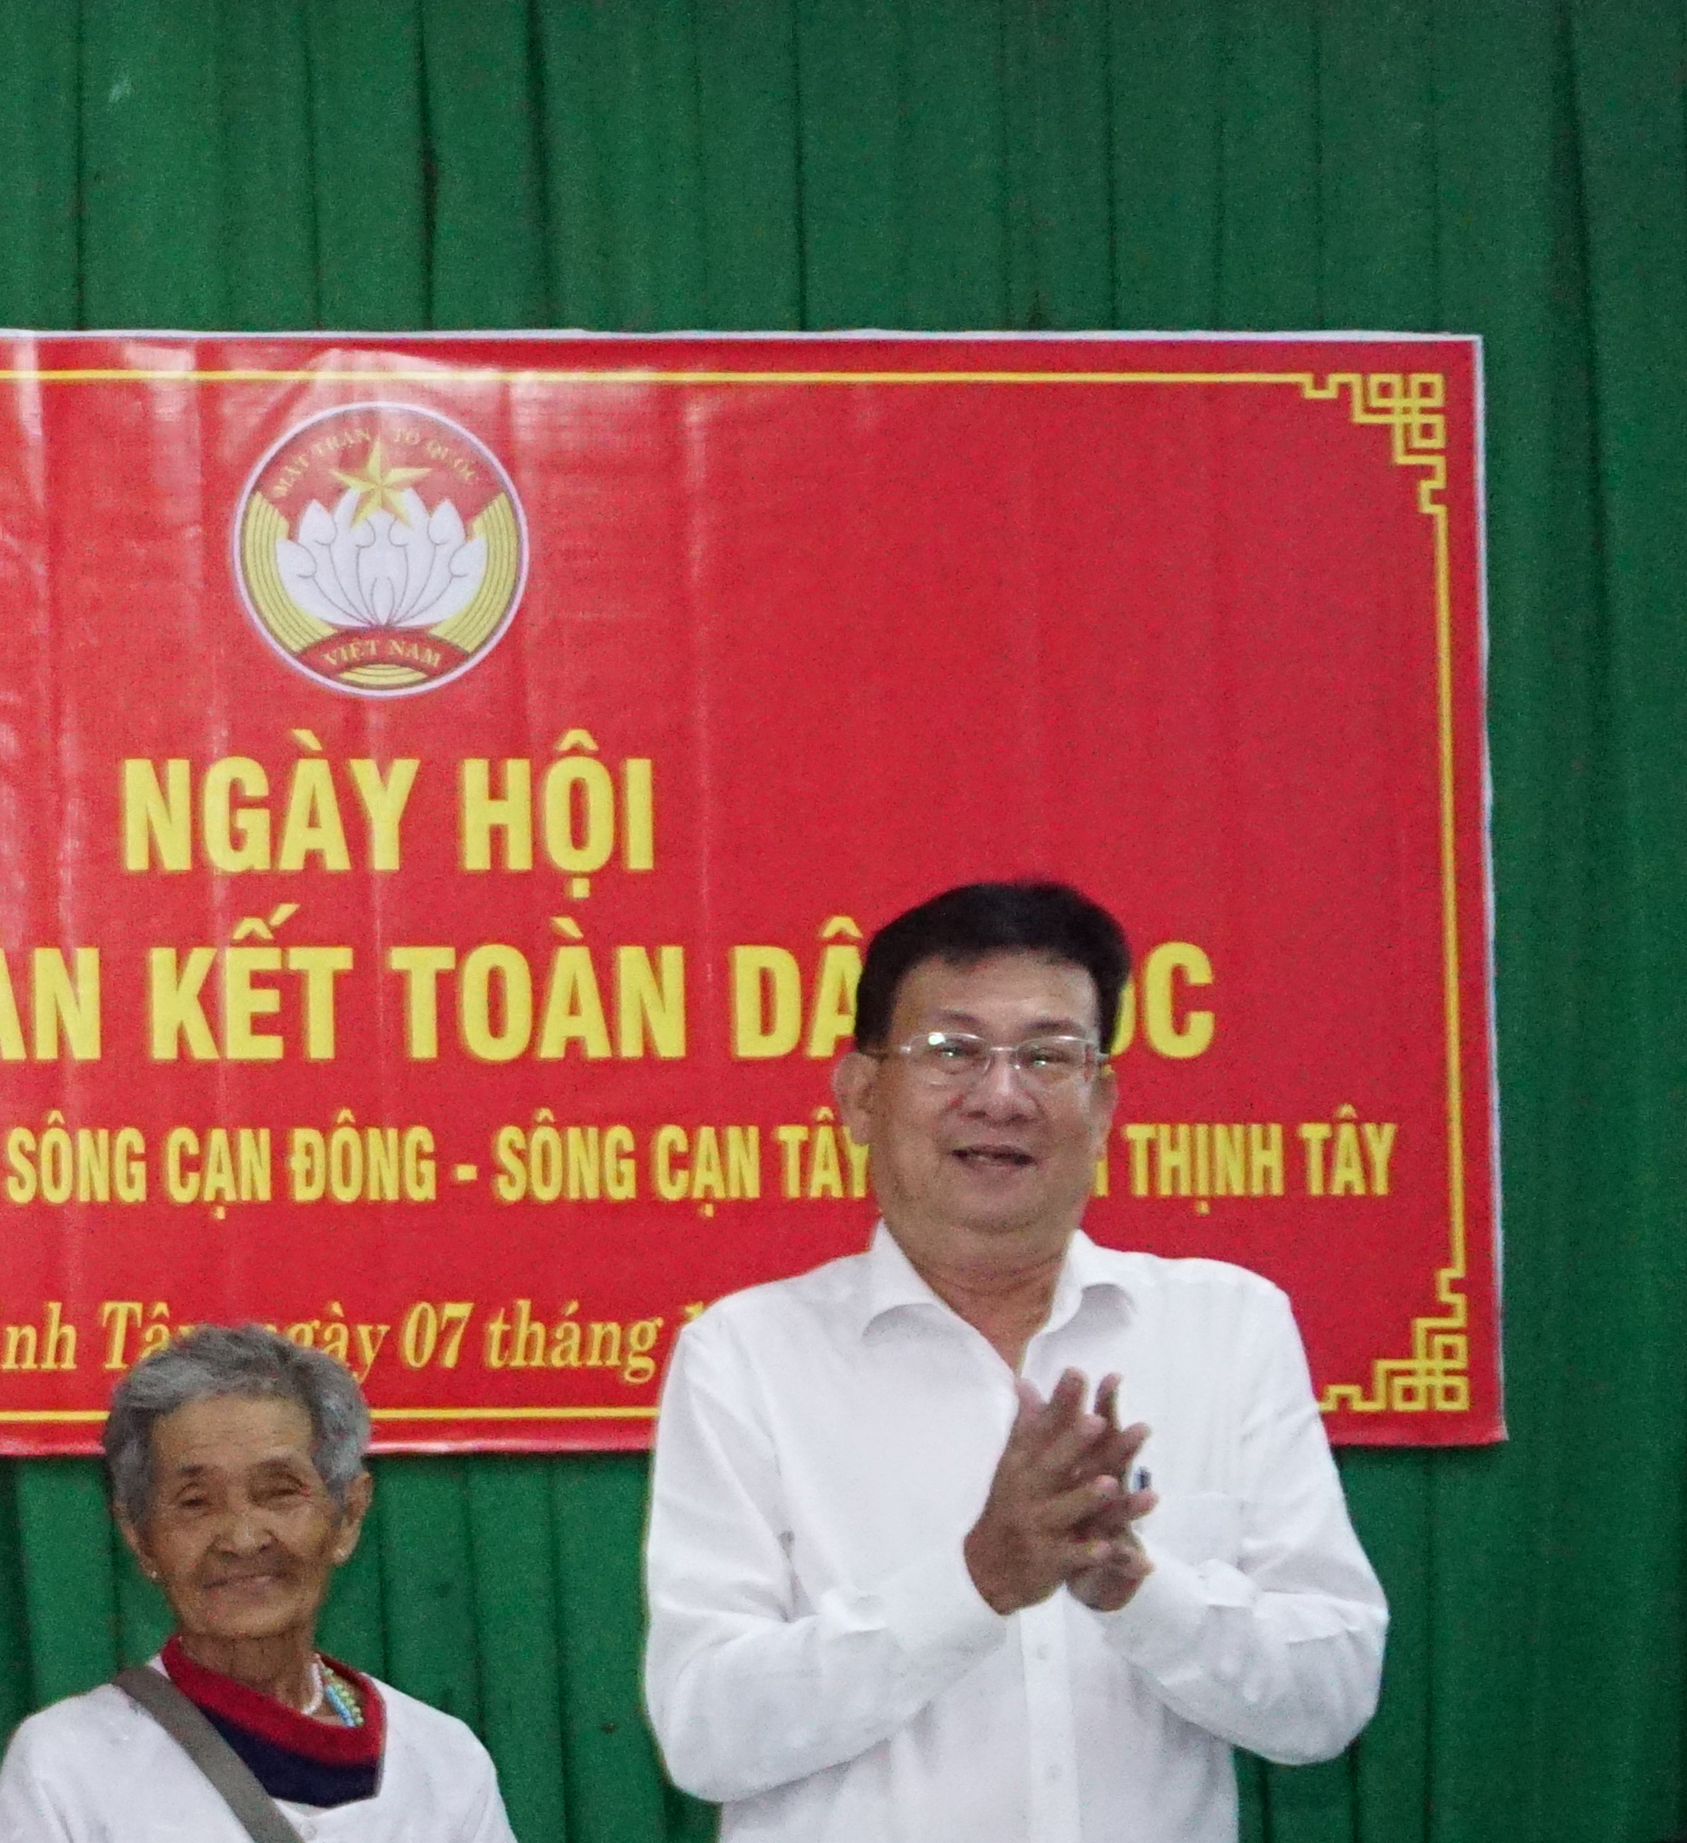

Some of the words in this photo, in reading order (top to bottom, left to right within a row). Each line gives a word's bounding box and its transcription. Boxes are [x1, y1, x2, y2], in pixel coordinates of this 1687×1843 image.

[388, 639, 442, 668] NAM
[120, 728, 421, 877] NGÀY
[461, 728, 655, 899] HỘI
[148, 903, 354, 1062] KẾT
[387, 916, 687, 1062] TOÀN
[731, 914, 863, 1059] DÂ
[4, 1109, 148, 1205] SÔNG
[164, 1125, 272, 1221] CẠN
[288, 1108, 438, 1204] ĐÔNG
[454, 1163, 478, 1182] -
[495, 1108, 637, 1203] SÔNG
[654, 1123, 761, 1218] CẠN
[1124, 1122, 1284, 1215] THỊNH
[1300, 1104, 1398, 1197] TÂY
[101, 1300, 194, 1370] Tâ
[264, 1300, 391, 1383] ày
[402, 1301, 475, 1369] 07
[488, 1299, 664, 1384] tháng
